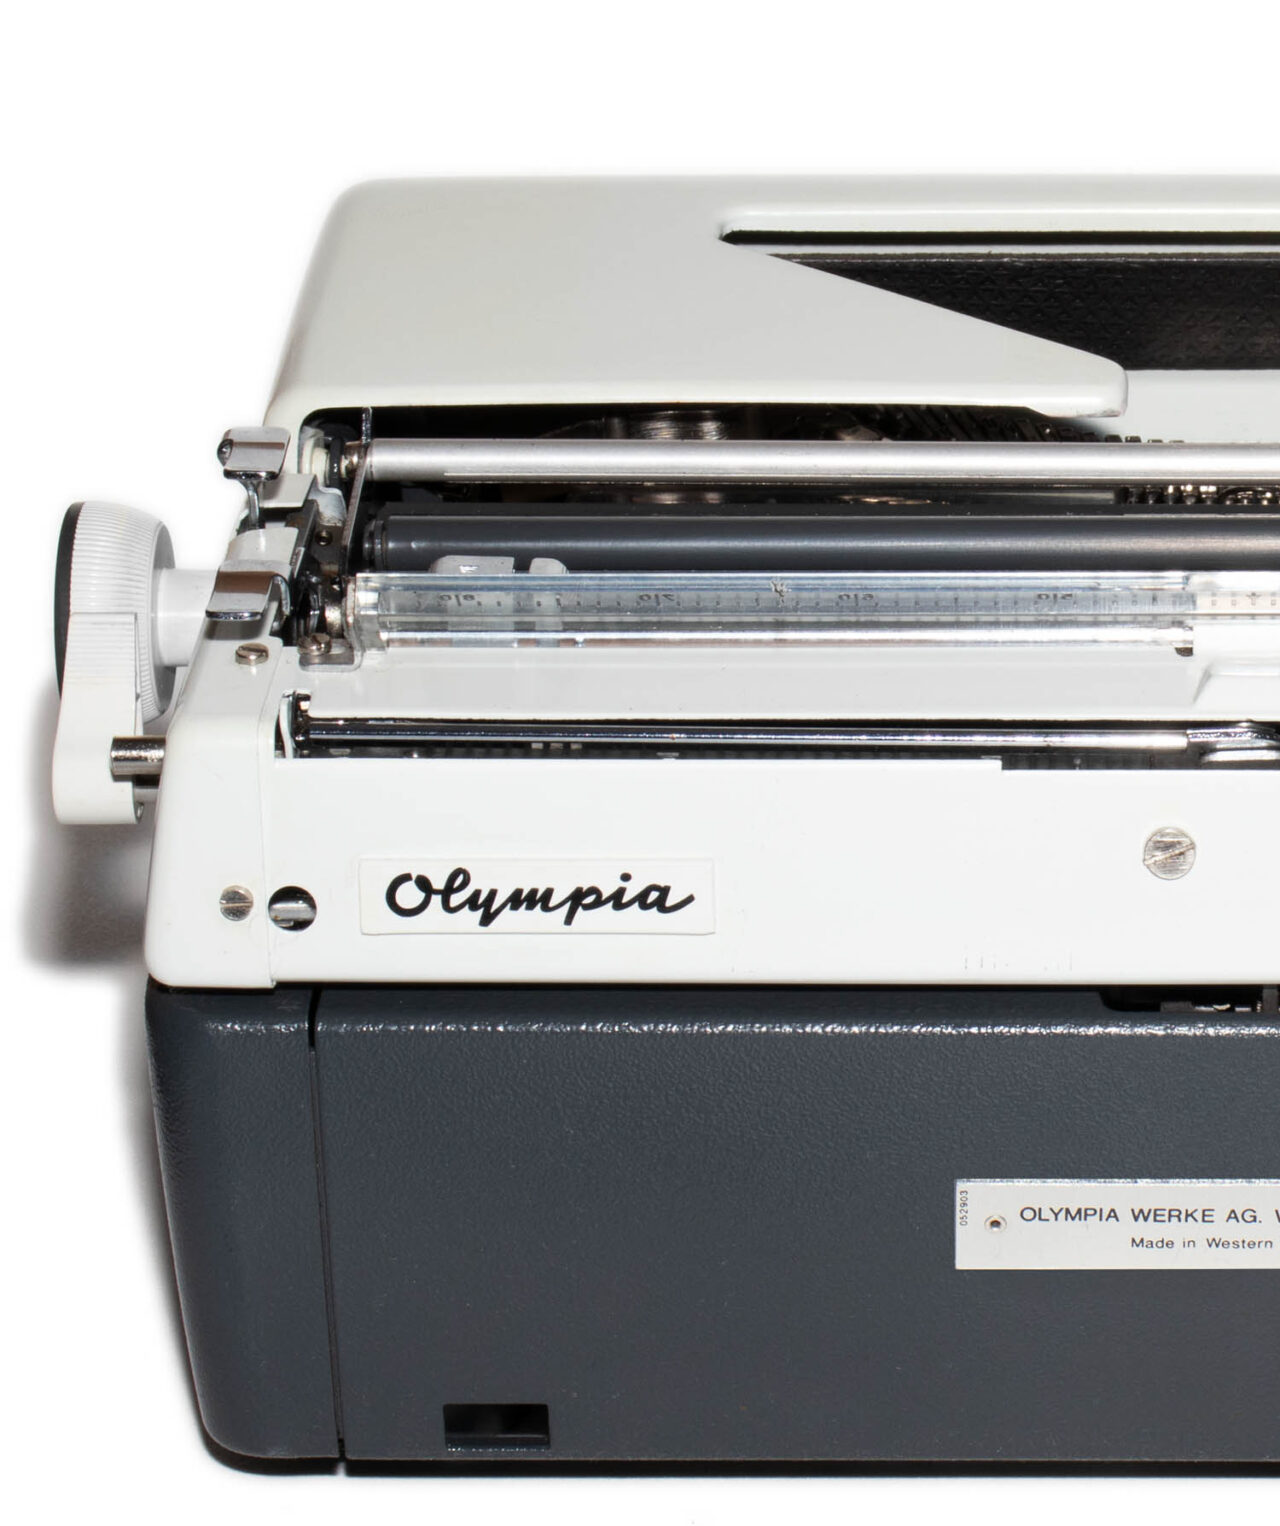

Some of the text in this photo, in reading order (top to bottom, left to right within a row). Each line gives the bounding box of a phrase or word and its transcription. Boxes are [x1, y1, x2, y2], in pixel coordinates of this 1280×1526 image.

[385, 867, 695, 927] Olympia
[959, 1190, 969, 1226] 052903
[1019, 1206, 1120, 1223] OLYMPIA
[1130, 1206, 1215, 1223] WERKE
[1225, 1206, 1262, 1223] AG.
[1131, 1237, 1175, 1251] Made
[1182, 1237, 1196, 1251] in
[1206, 1237, 1273, 1251] Western
